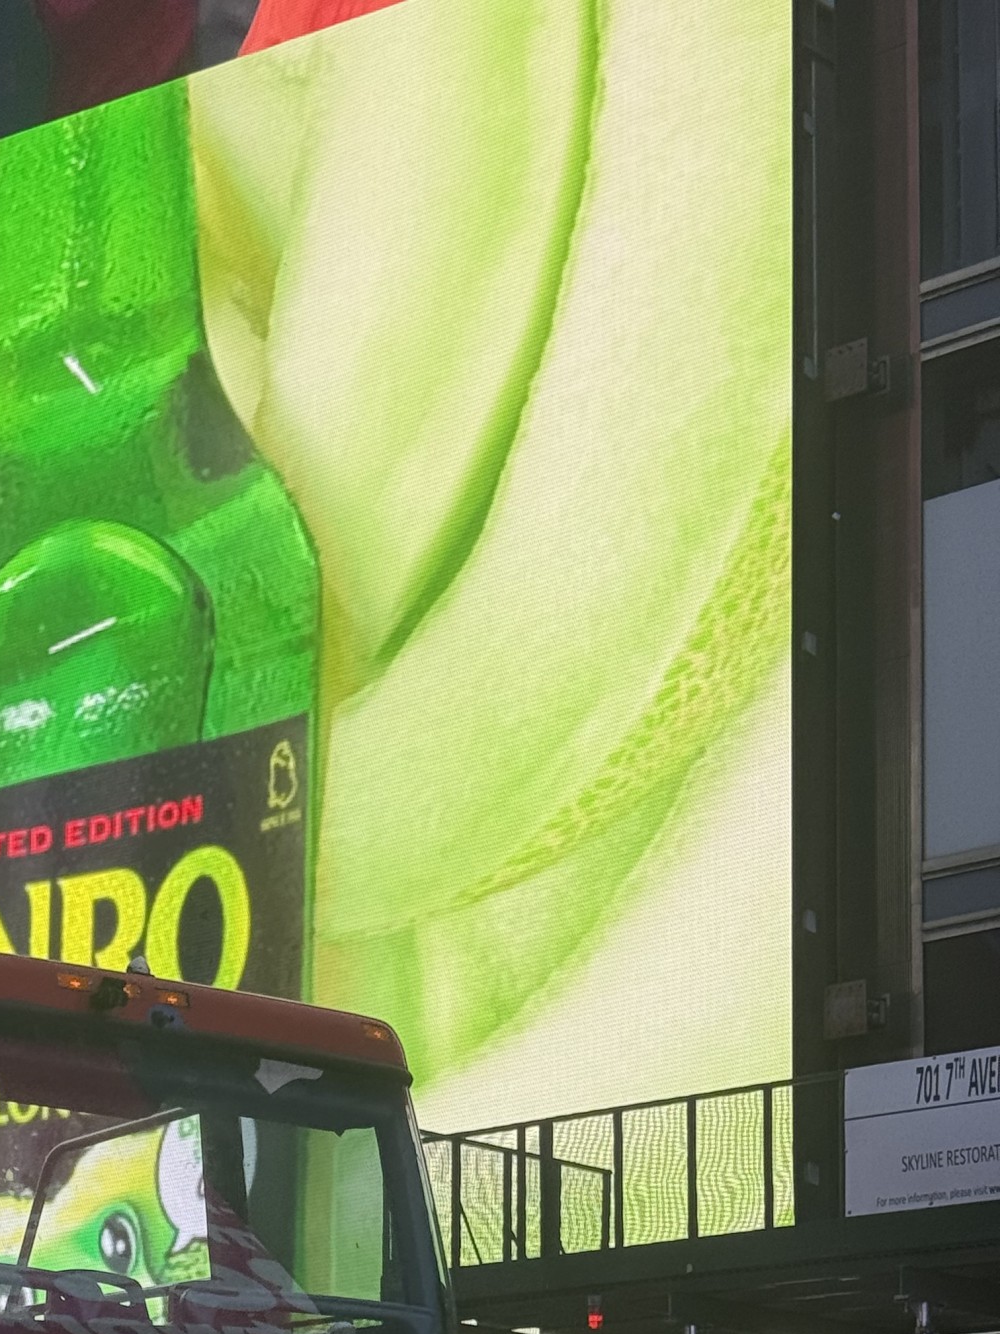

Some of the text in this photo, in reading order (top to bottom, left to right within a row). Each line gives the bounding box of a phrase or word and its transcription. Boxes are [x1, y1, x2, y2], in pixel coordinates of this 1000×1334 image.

[65, 794, 205, 847] EDITION
[916, 1064, 940, 1104] 701
[968, 1055, 1000, 1097] AVE
[902, 1150, 943, 1173] SKYLINE
[949, 1187, 972, 1200] please
